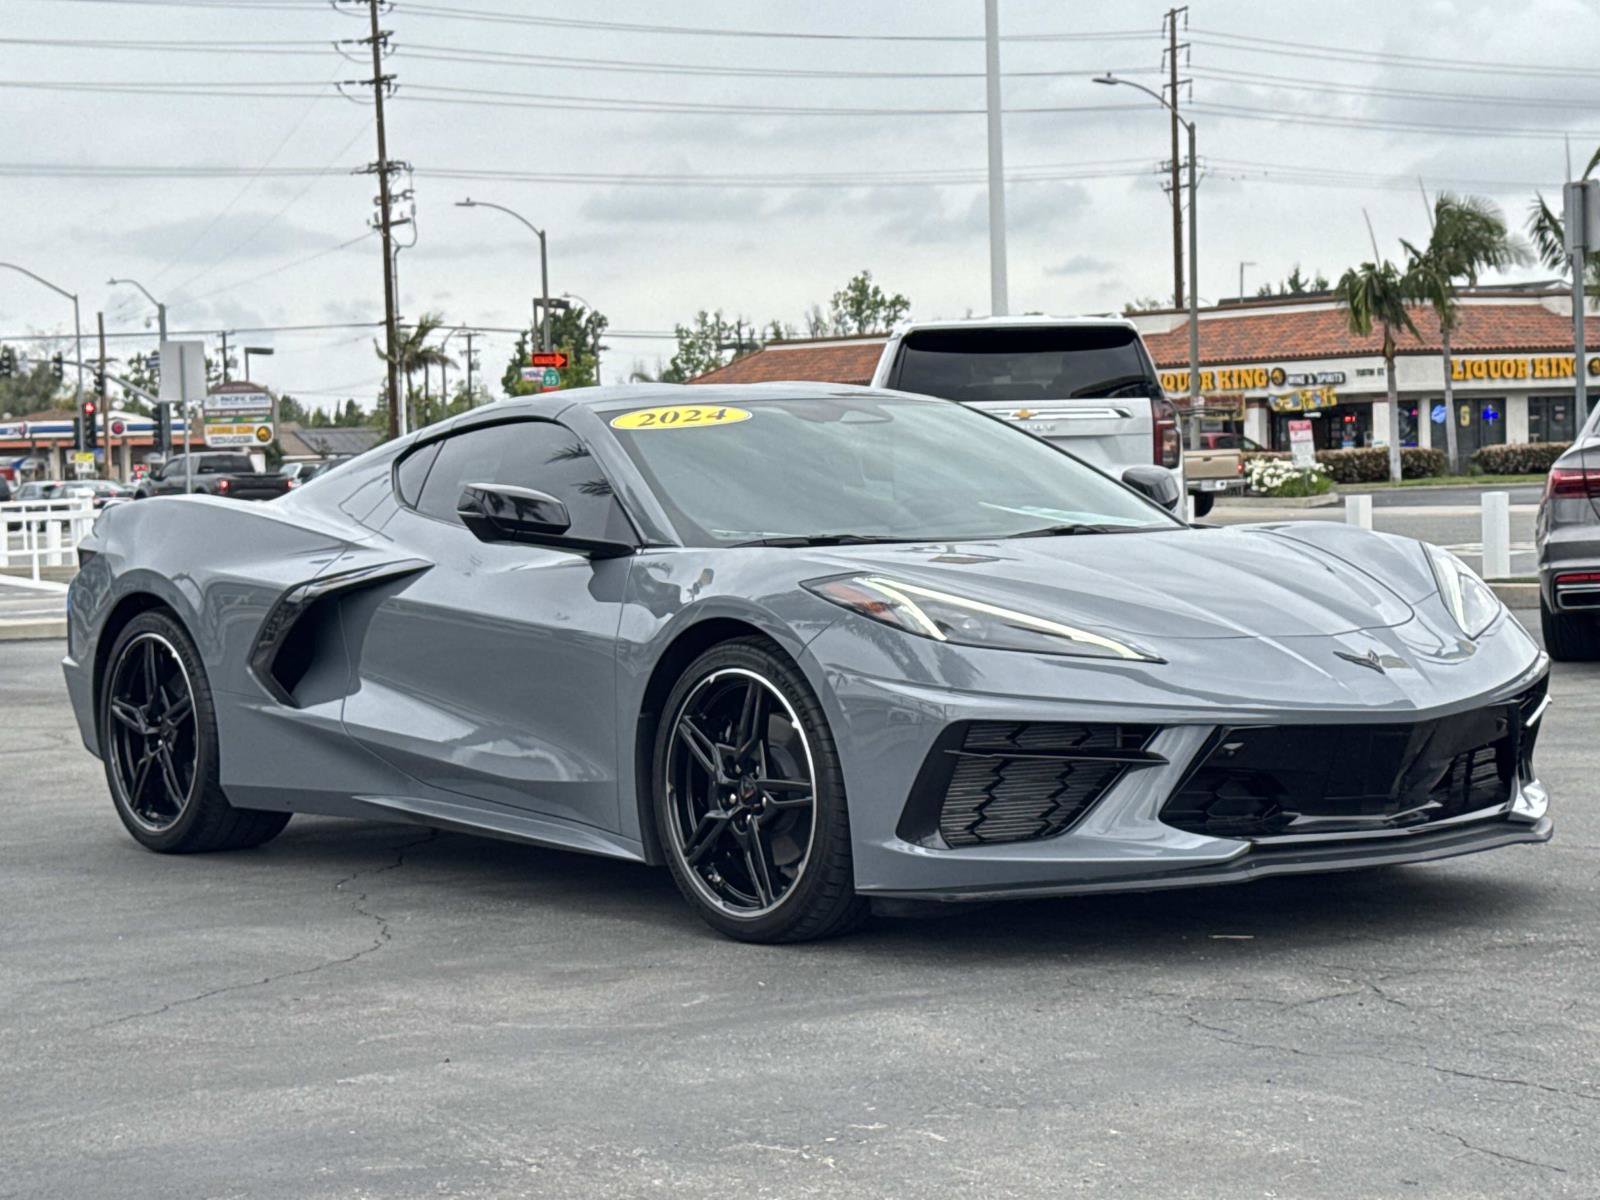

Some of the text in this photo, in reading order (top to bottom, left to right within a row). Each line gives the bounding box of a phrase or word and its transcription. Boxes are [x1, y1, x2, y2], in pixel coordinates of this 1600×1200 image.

[1317, 371, 1345, 385] SPIRITS
[1450, 356, 1576, 381] LIQUOR KIN
[1161, 367, 1269, 393] QUR KING
[637, 408, 728, 427] 2024
